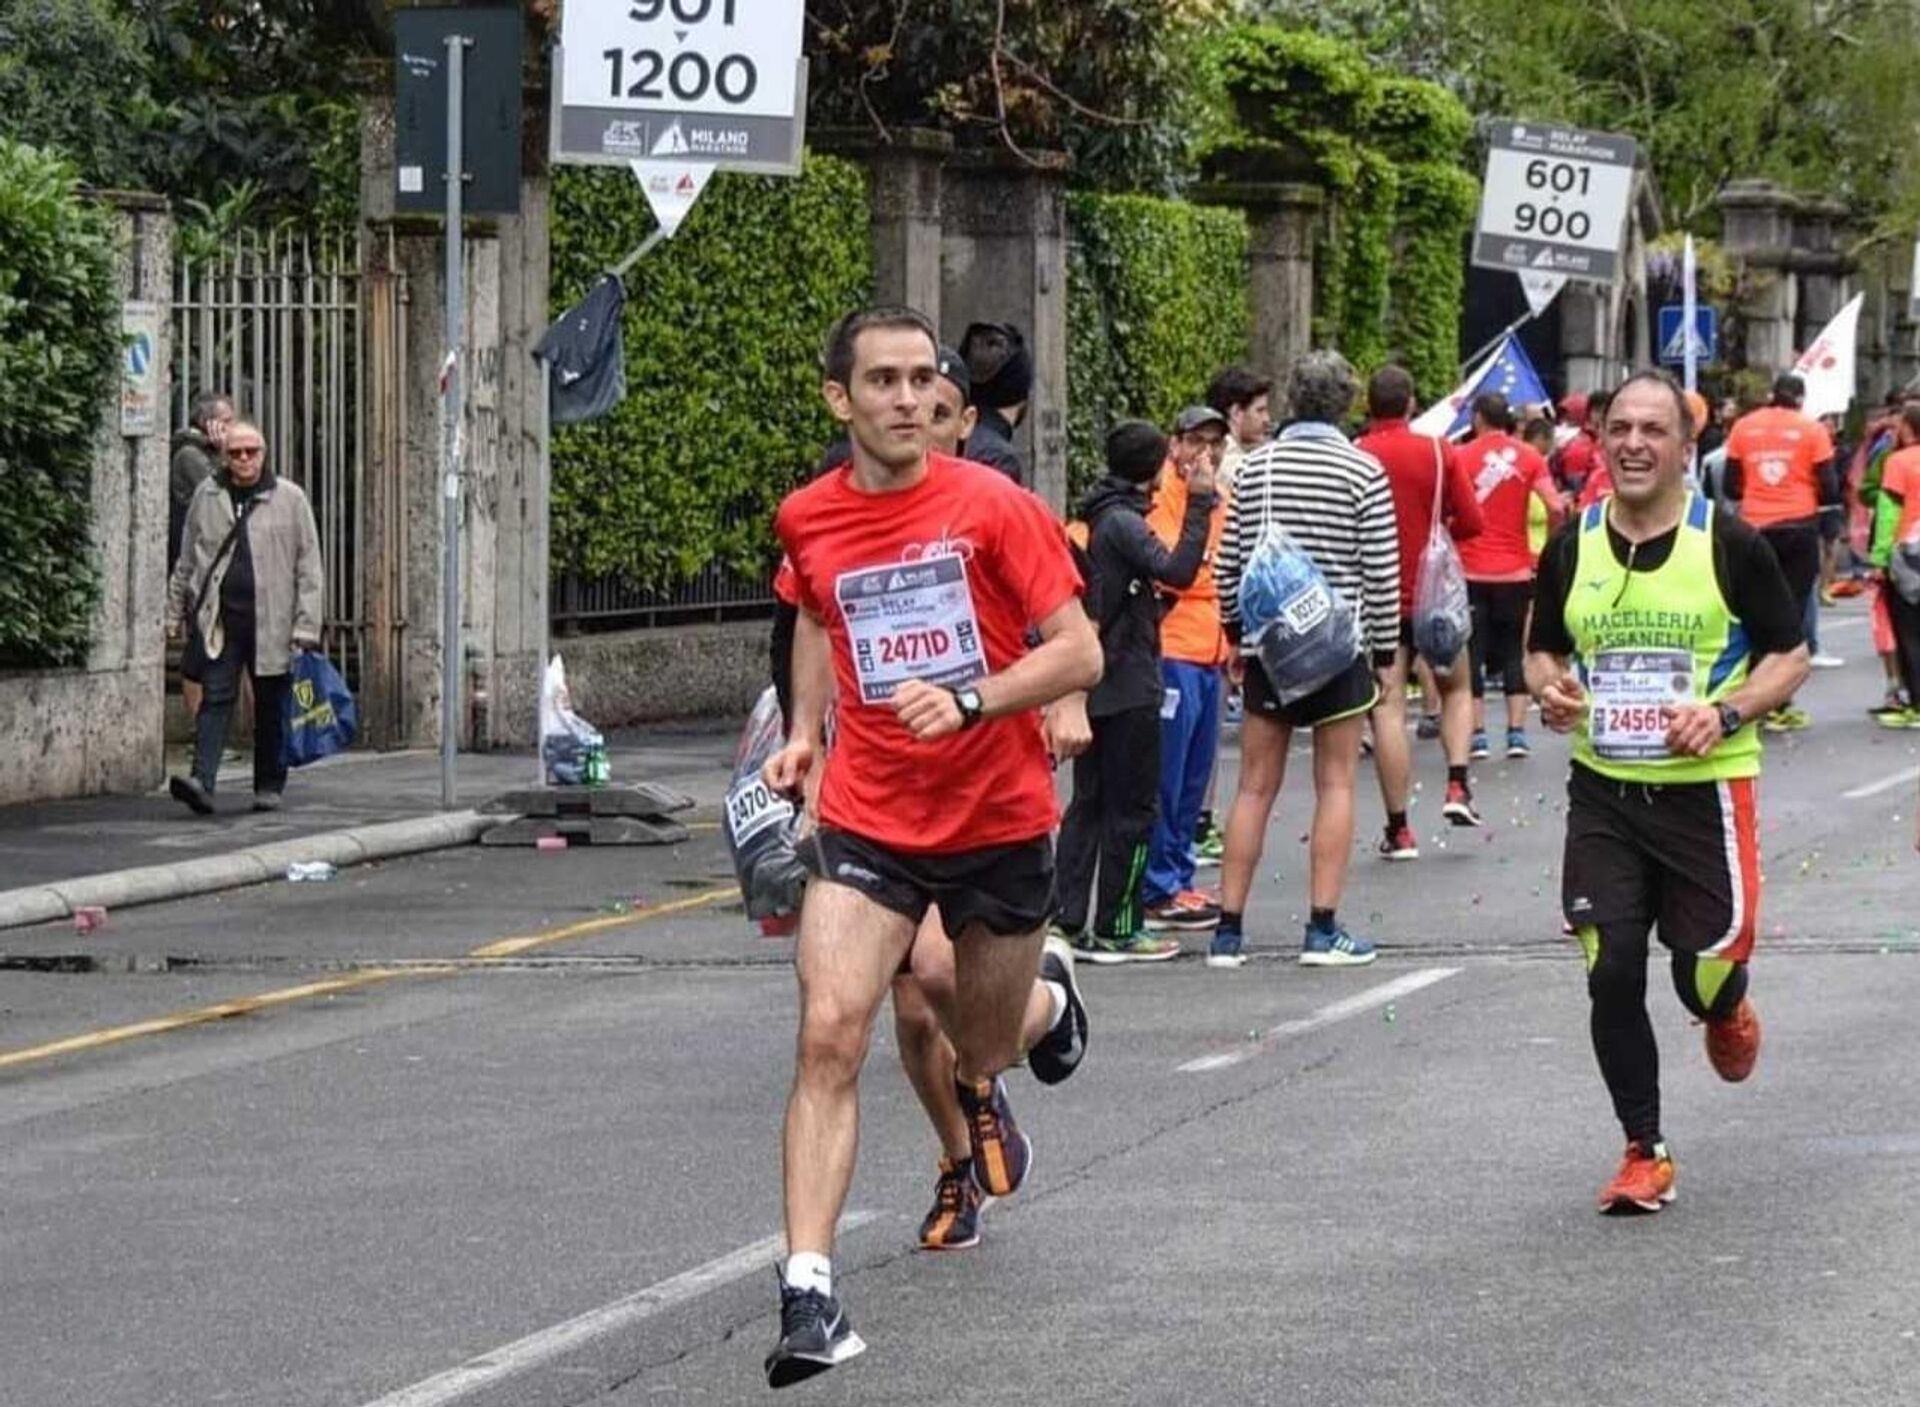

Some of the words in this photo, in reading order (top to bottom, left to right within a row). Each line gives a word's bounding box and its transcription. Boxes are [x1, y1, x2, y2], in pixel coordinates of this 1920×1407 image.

[603, 48, 757, 103] 1200
[691, 129, 748, 145] MILANO
[1526, 160, 1590, 195] 601
[1514, 203, 1590, 240] 900
[1583, 611, 1704, 632] MACELLERIA
[879, 629, 949, 664] 2471D
